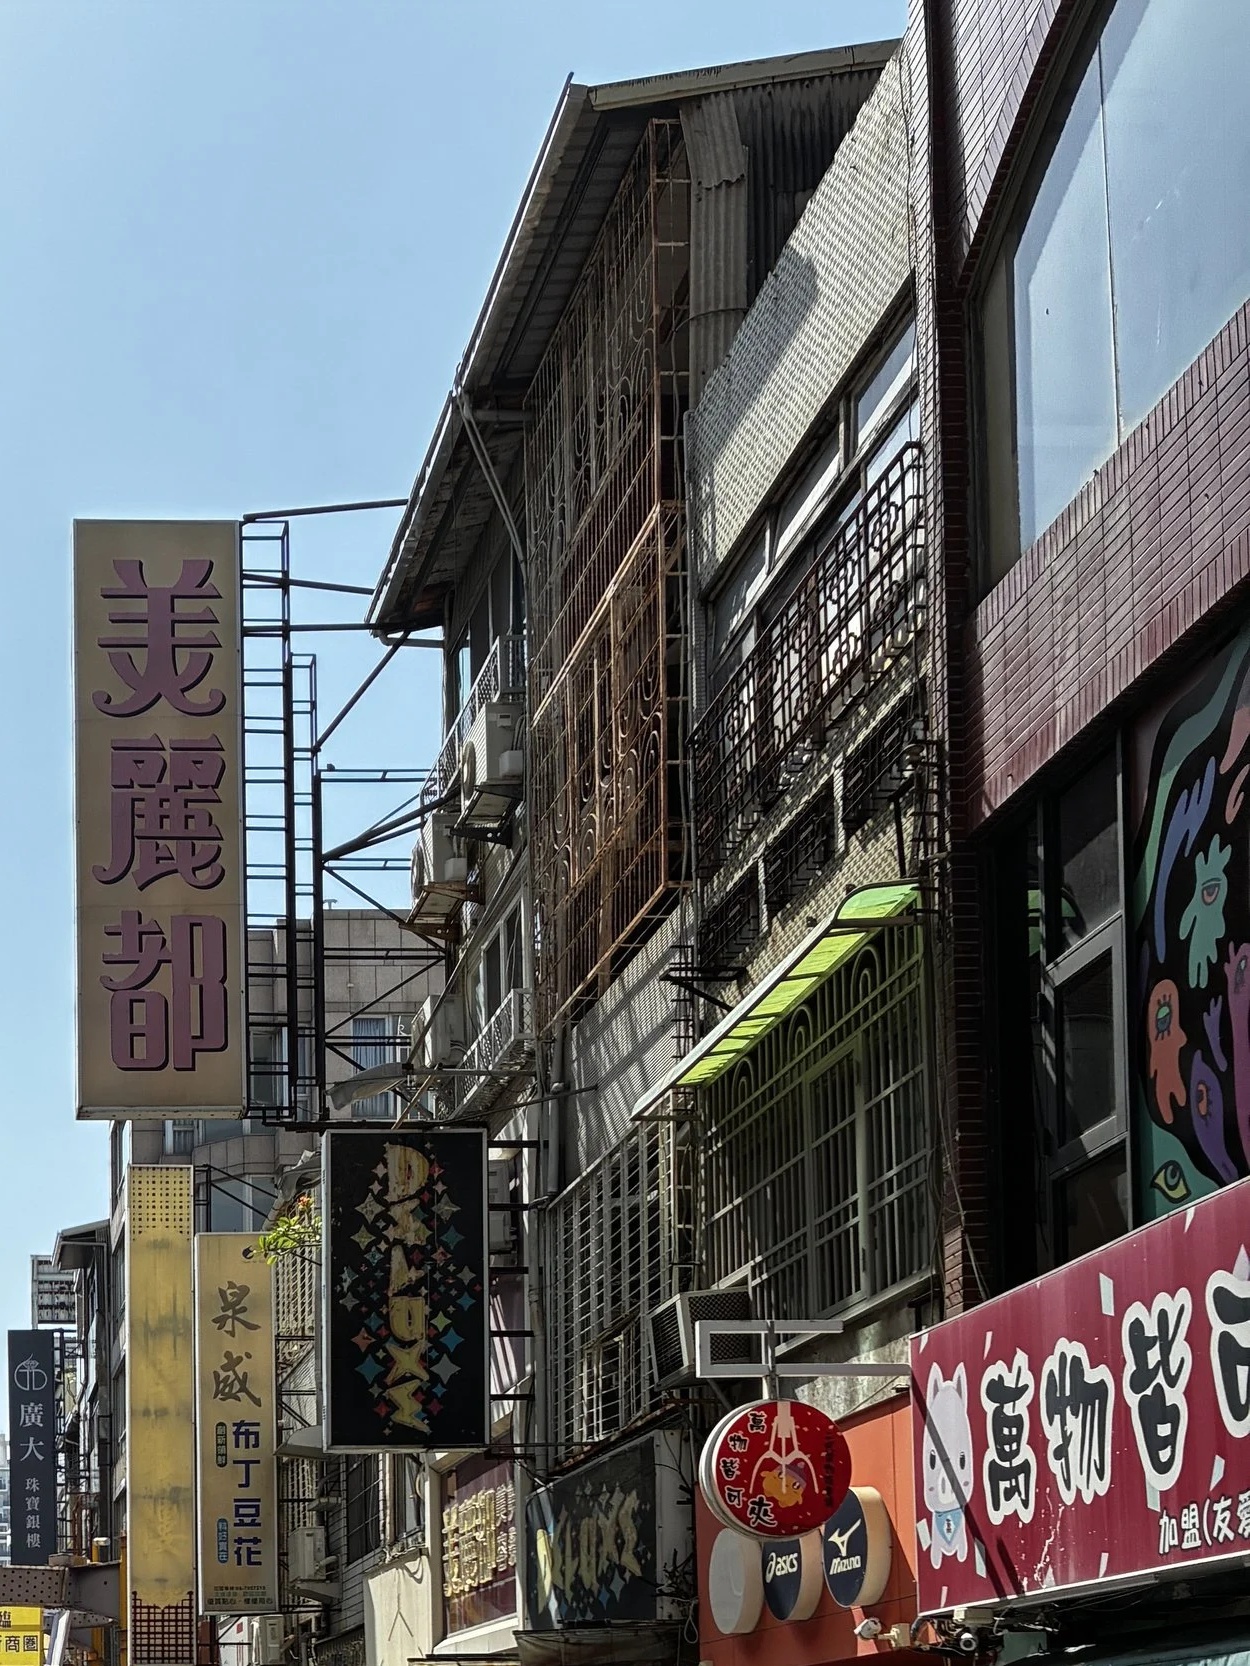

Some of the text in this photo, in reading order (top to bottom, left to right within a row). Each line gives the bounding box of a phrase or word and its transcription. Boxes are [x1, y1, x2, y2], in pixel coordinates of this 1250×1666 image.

[92, 559, 226, 1072] 美麗都
[19, 1401, 45, 1462] 廣大
[232, 1419, 262, 1566] 布丁豆花
